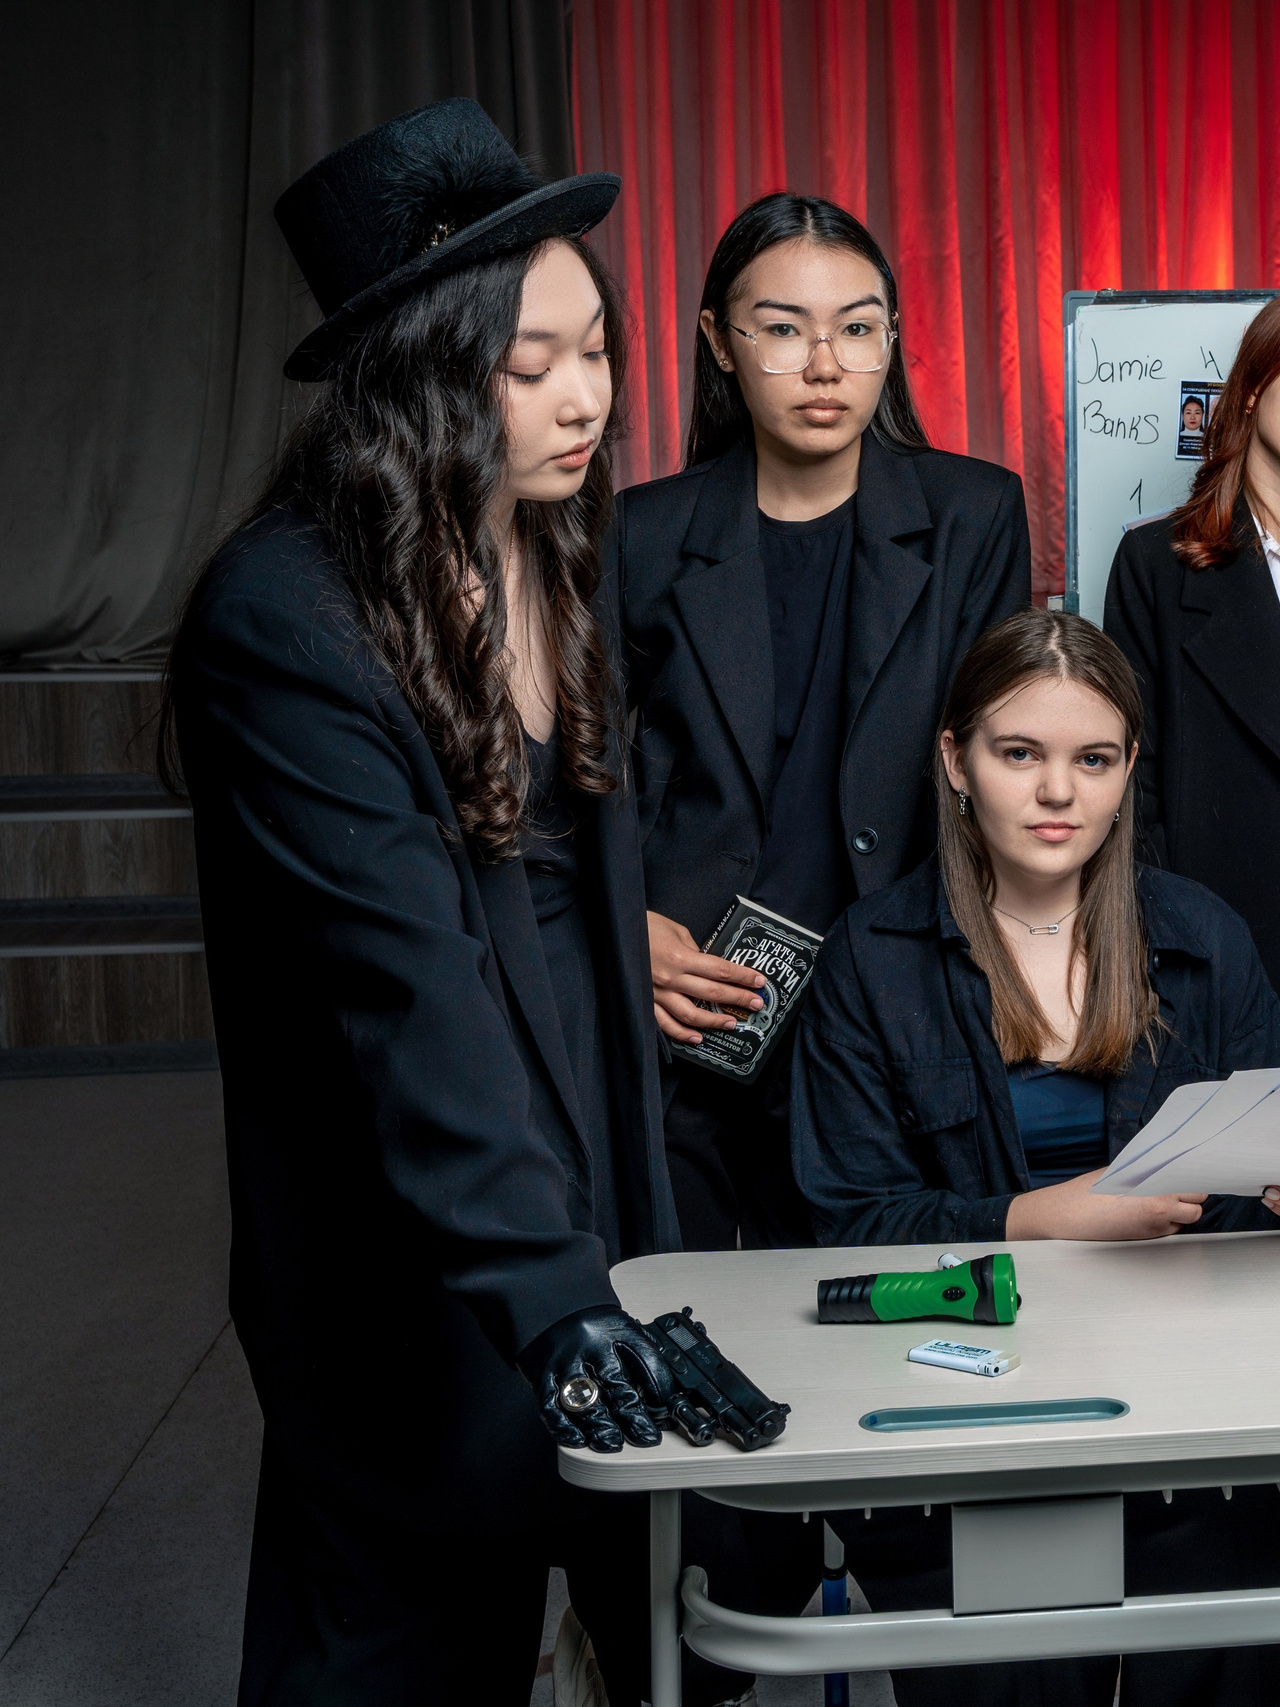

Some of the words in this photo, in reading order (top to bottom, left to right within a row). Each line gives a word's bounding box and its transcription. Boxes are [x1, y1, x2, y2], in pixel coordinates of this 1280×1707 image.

[1077, 338, 1167, 384] Jamie
[756, 938, 795, 965] АГАТА
[730, 948, 800, 994] КРИСТИ
[701, 1033, 741, 1052] ИФЕРБЛАТОВ
